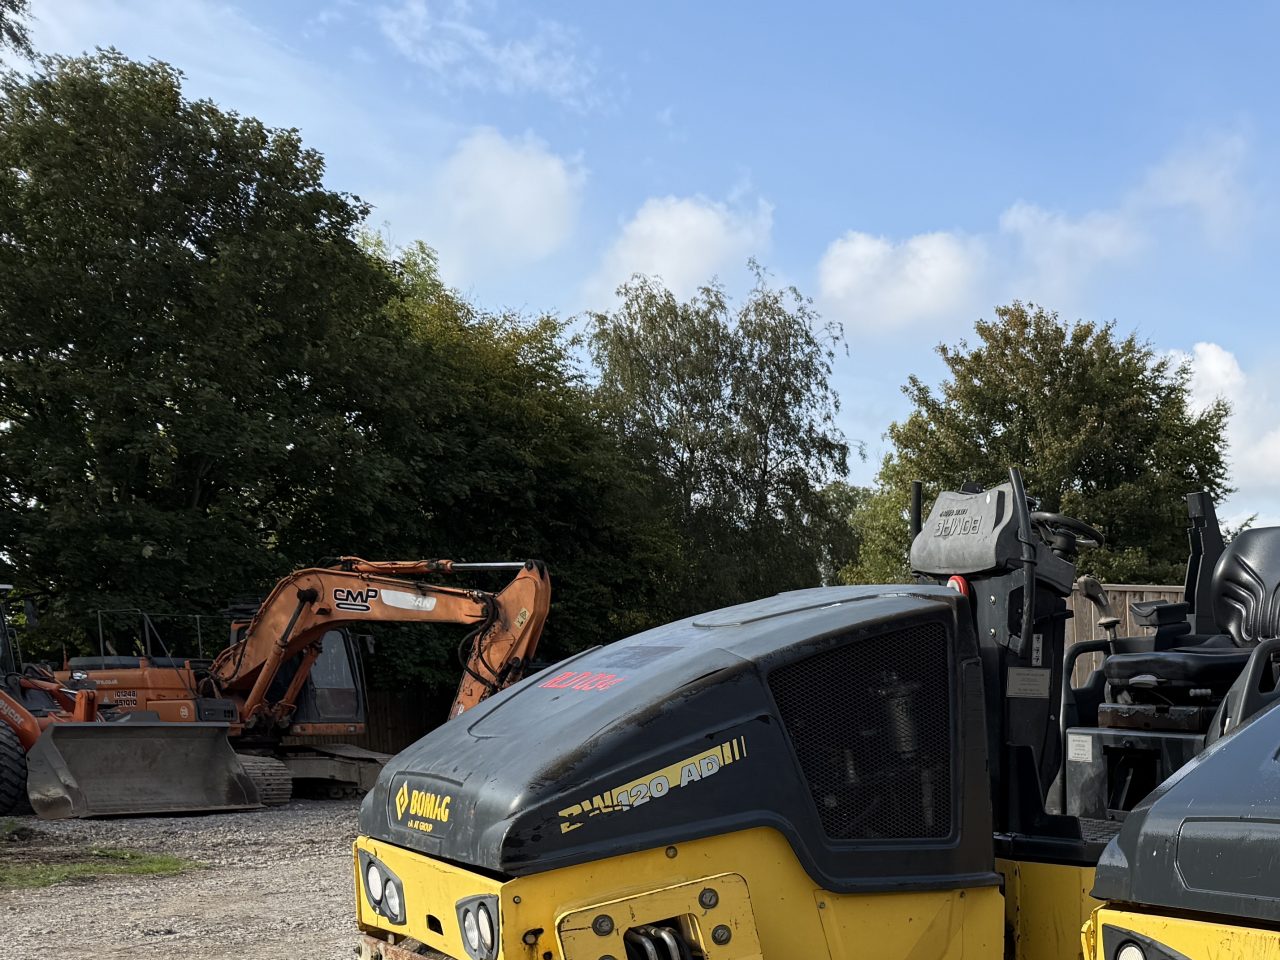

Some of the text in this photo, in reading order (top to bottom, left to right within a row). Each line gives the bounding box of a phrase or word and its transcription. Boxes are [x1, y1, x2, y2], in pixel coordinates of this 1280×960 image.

[933, 516, 983, 538] BOMAG
[333, 588, 378, 604] CMP
[680, 754, 721, 788] AD
[409, 789, 451, 822] BOMAG
